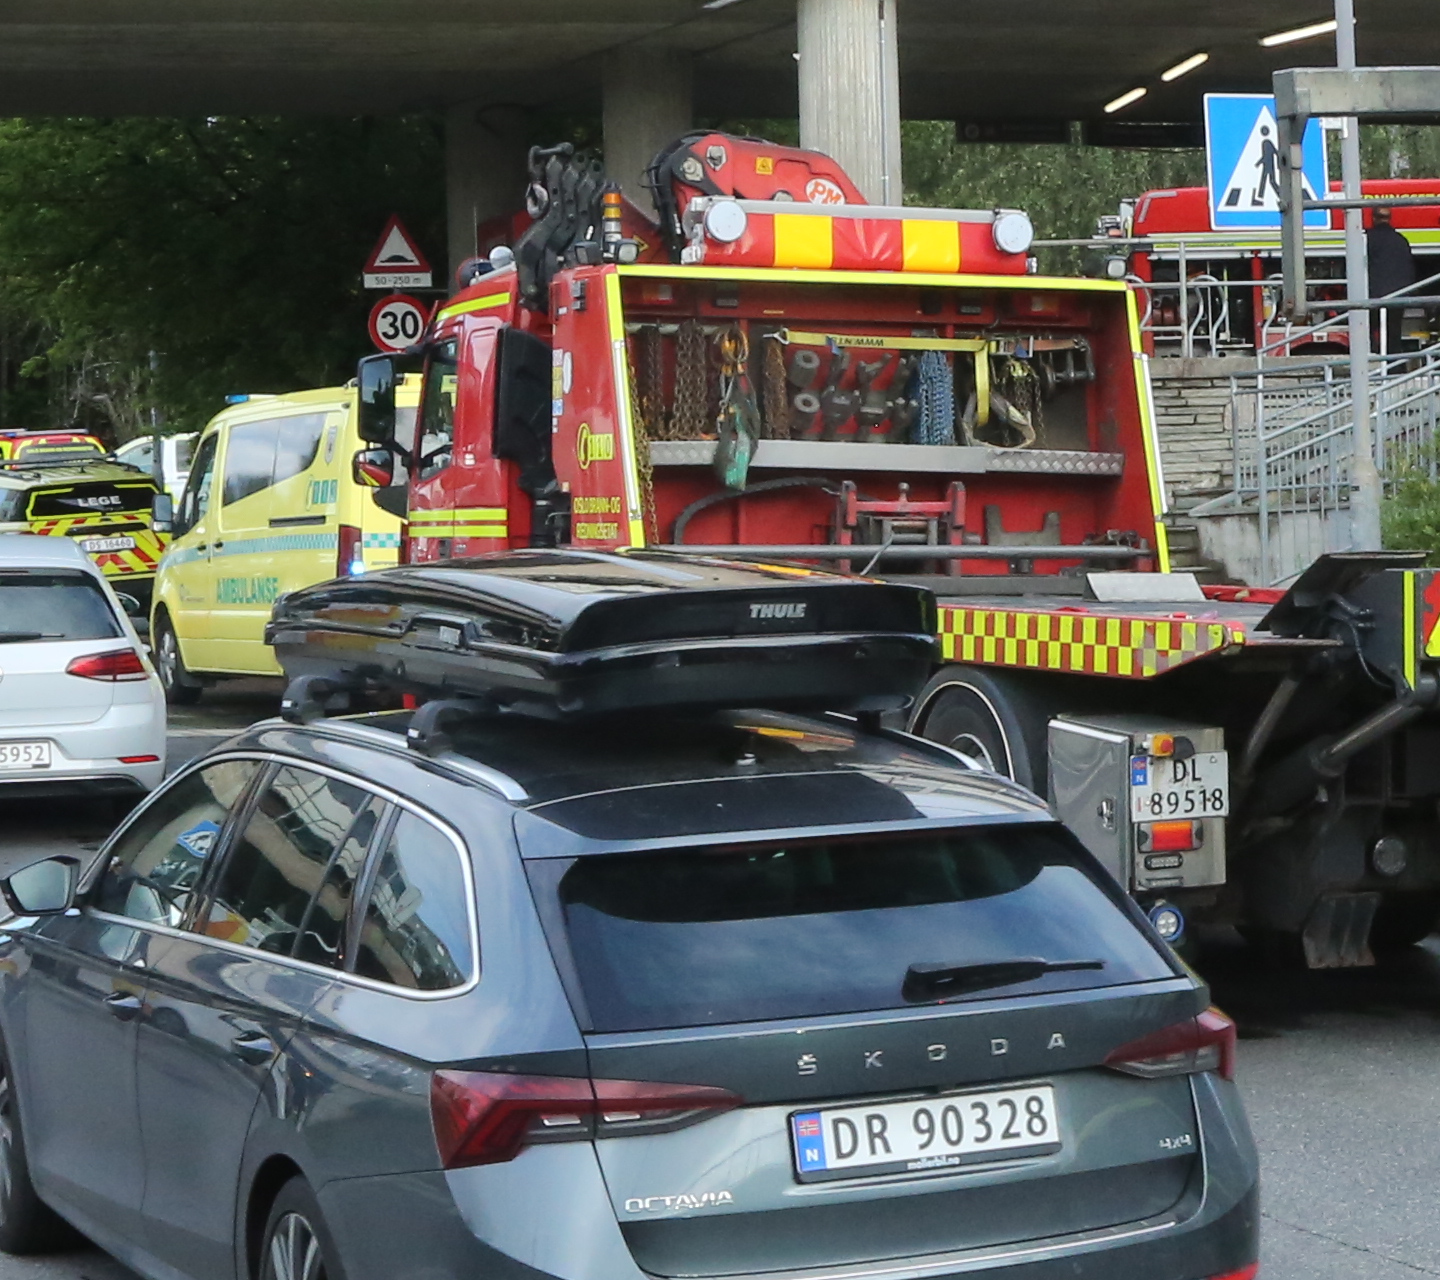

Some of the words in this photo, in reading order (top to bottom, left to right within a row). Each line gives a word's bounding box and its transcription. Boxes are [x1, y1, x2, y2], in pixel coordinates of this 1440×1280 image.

[380, 309, 420, 340] 30
[589, 433, 614, 461] 110
[76, 495, 122, 508] LEGE
[101, 538, 133, 550] 16460
[216, 576, 279, 605] AMBULANSE
[749, 602, 807, 619] THULE
[1172, 758, 1203, 784] DL
[1150, 787, 1225, 816] 89518
[831, 1112, 894, 1161] DR
[911, 1093, 1050, 1152] 90328
[1159, 1133, 1193, 1150] 4x4
[624, 1190, 735, 1214] OCTAVIA
